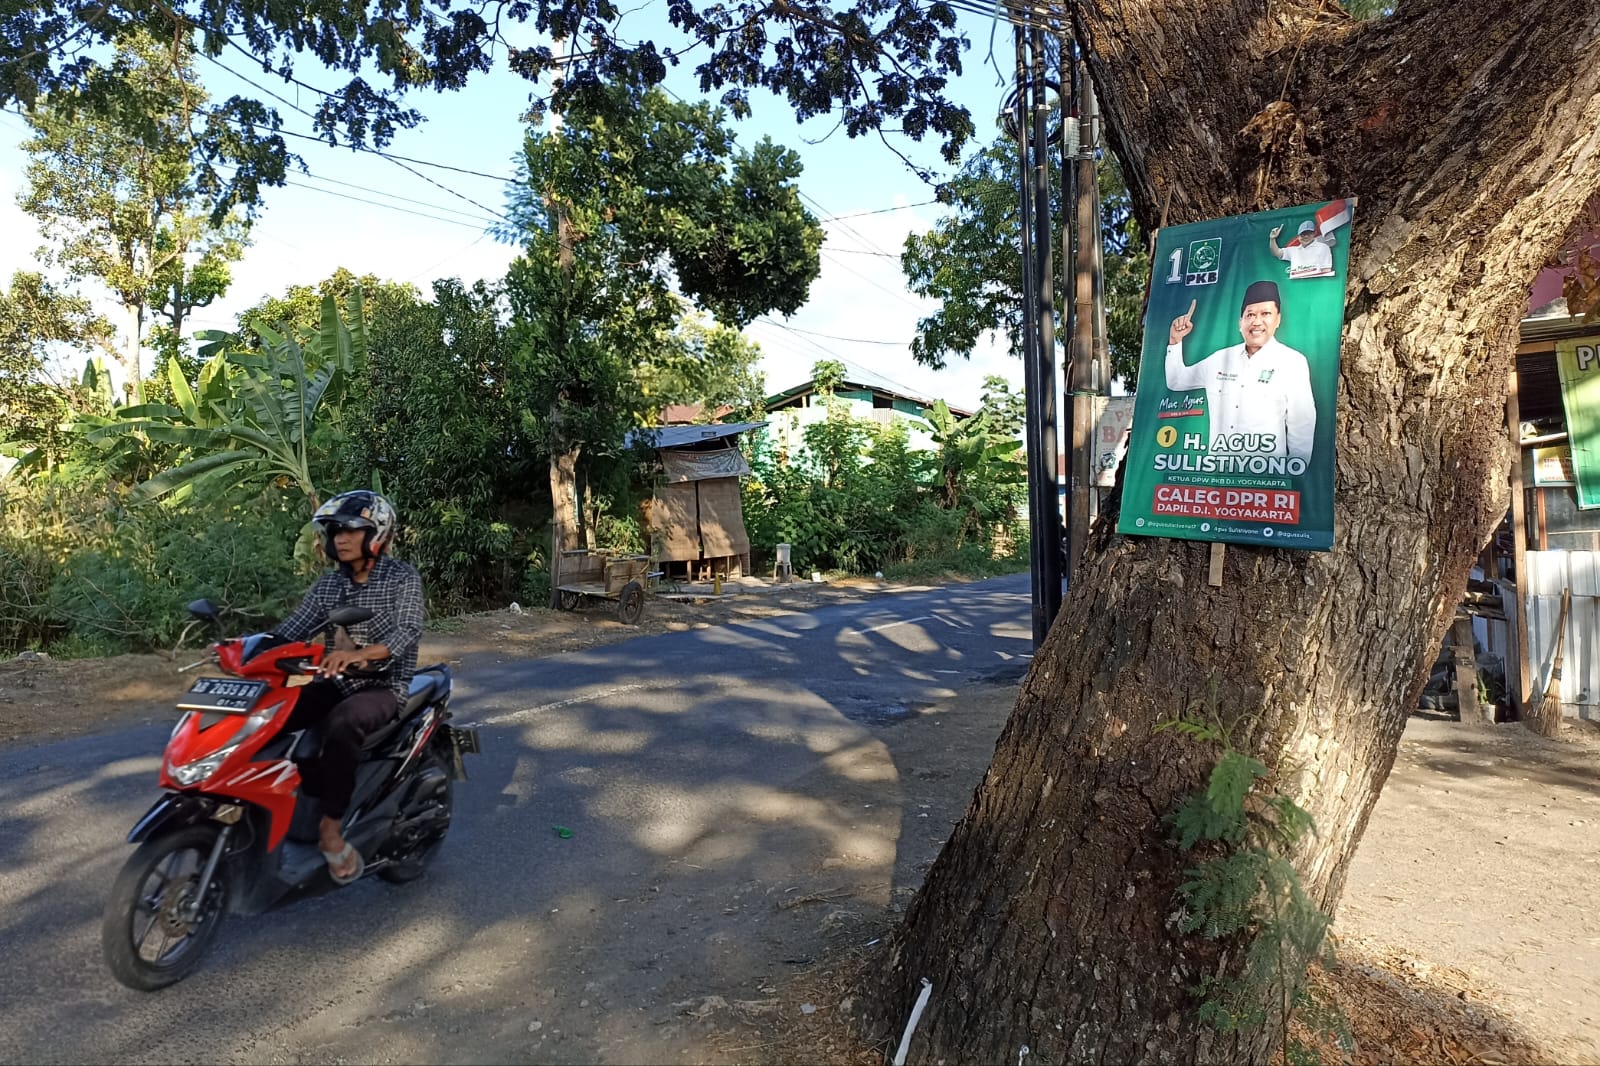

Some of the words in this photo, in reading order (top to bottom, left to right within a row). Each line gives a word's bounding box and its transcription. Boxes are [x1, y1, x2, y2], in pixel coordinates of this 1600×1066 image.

[1167, 248, 1182, 283] 1
[1186, 272, 1217, 285] PKB
[1159, 397, 1178, 410] Mas
[1182, 394, 1204, 409] Agus
[1183, 433, 1207, 450] H.
[1211, 434, 1277, 453] AGUS
[1153, 453, 1307, 476] SULISTIYONO
[1168, 475, 1190, 483] KETUA
[1237, 479, 1286, 487] YOGYAKARTA
[1157, 487, 1220, 505] CALEG
[1225, 491, 1267, 508] DPR
[1274, 493, 1295, 510] RI
[1157, 503, 1189, 513] DAPIL
[1192, 506, 1211, 515] D.I.
[1214, 507, 1294, 521] YOGYAKARTA
